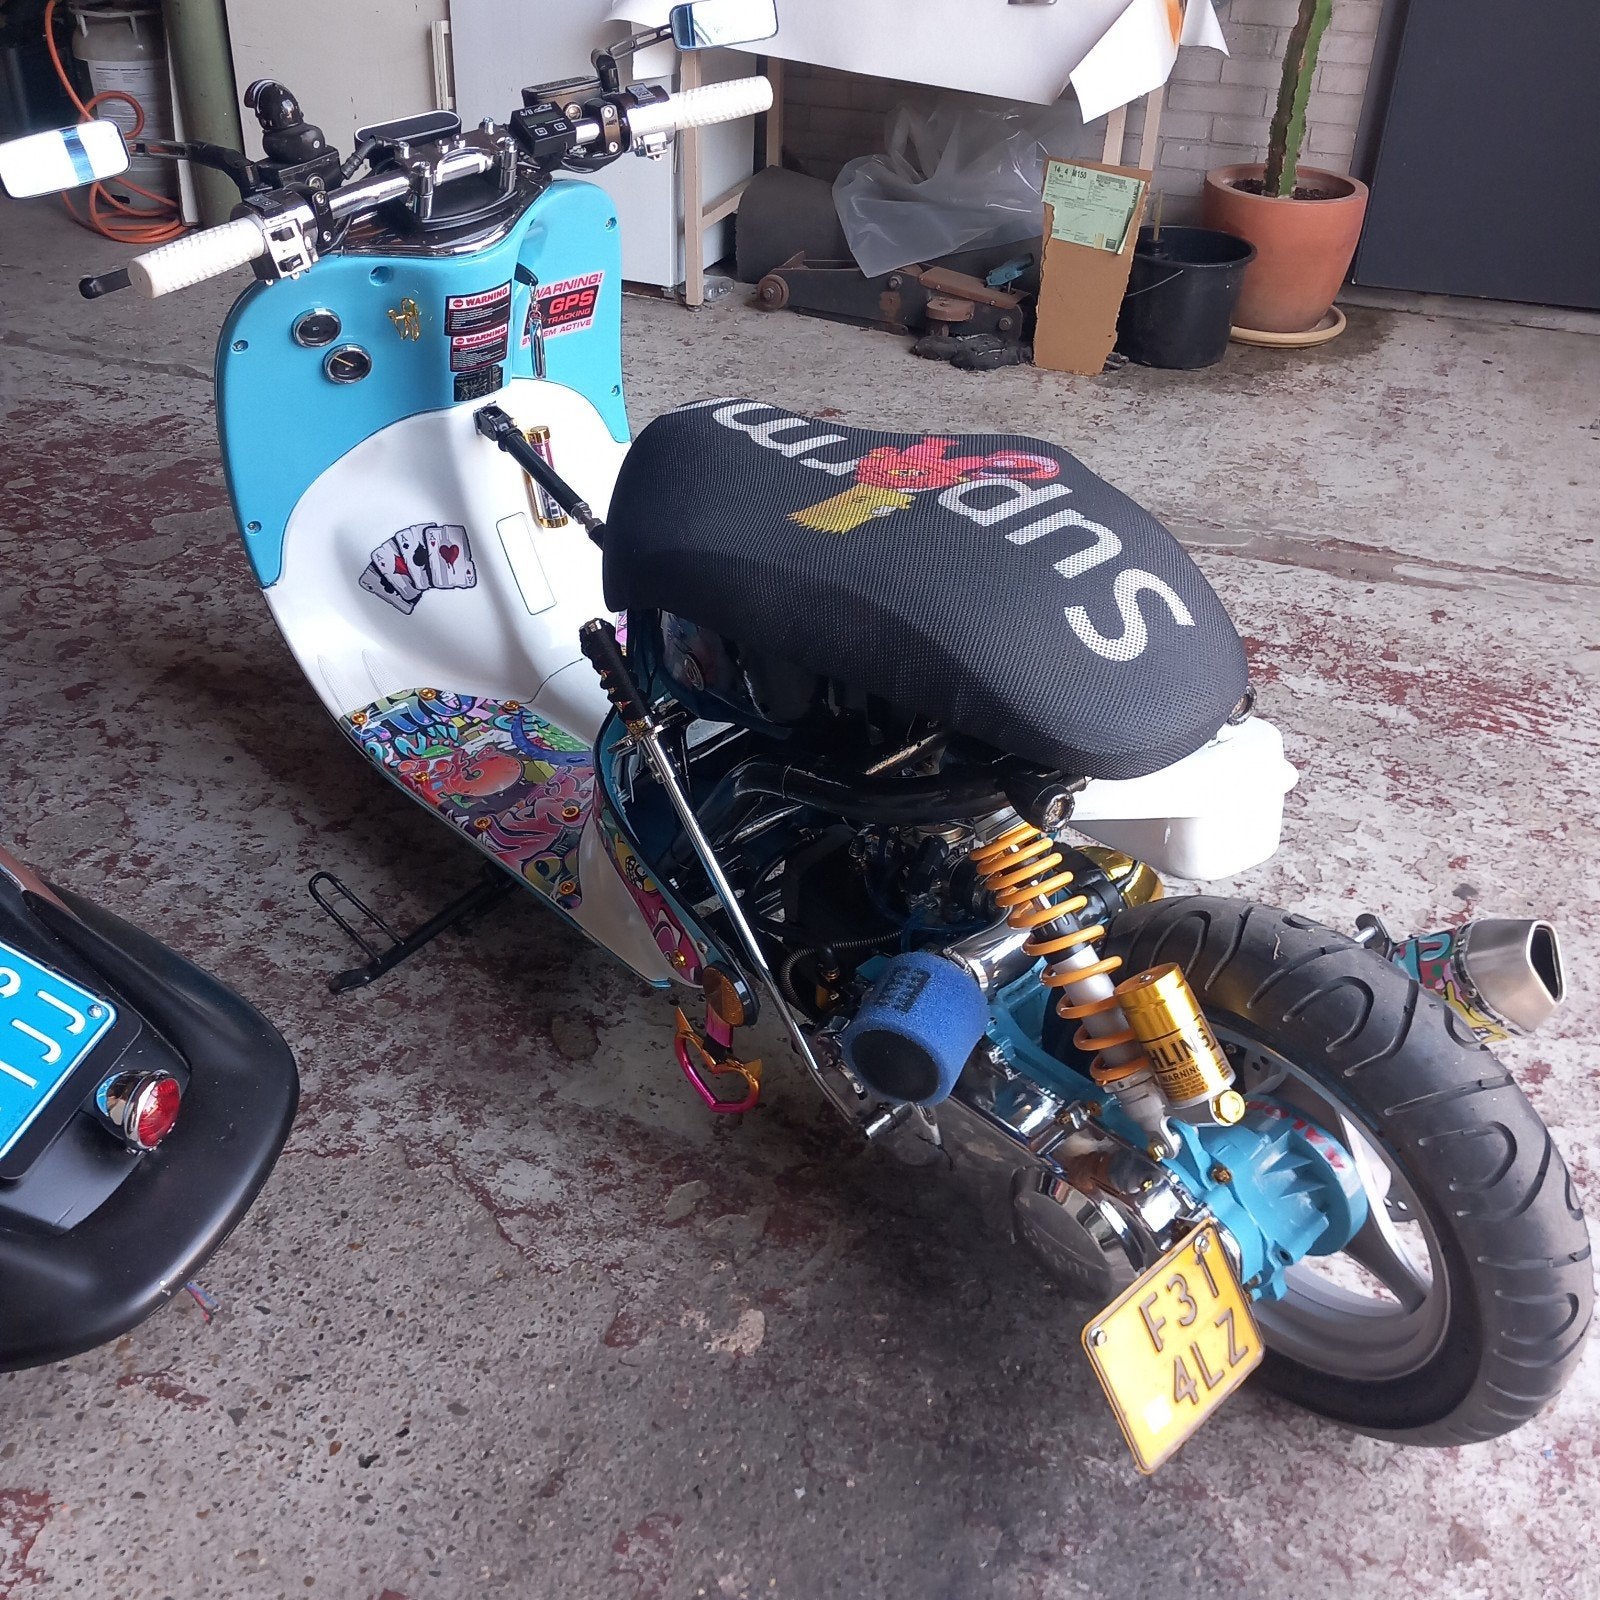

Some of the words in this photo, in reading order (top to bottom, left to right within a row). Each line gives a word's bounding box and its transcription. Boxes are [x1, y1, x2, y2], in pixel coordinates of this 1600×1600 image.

[465, 286, 508, 306] WARNING
[534, 272, 603, 298] WARNING!
[549, 289, 595, 315] GPS
[547, 307, 591, 325] TRACKING
[559, 318, 592, 333] ACTIVE
[465, 326, 506, 343] WARNING
[1138, 1253, 1219, 1353] F31
[1173, 1307, 1249, 1406] 4LZ
